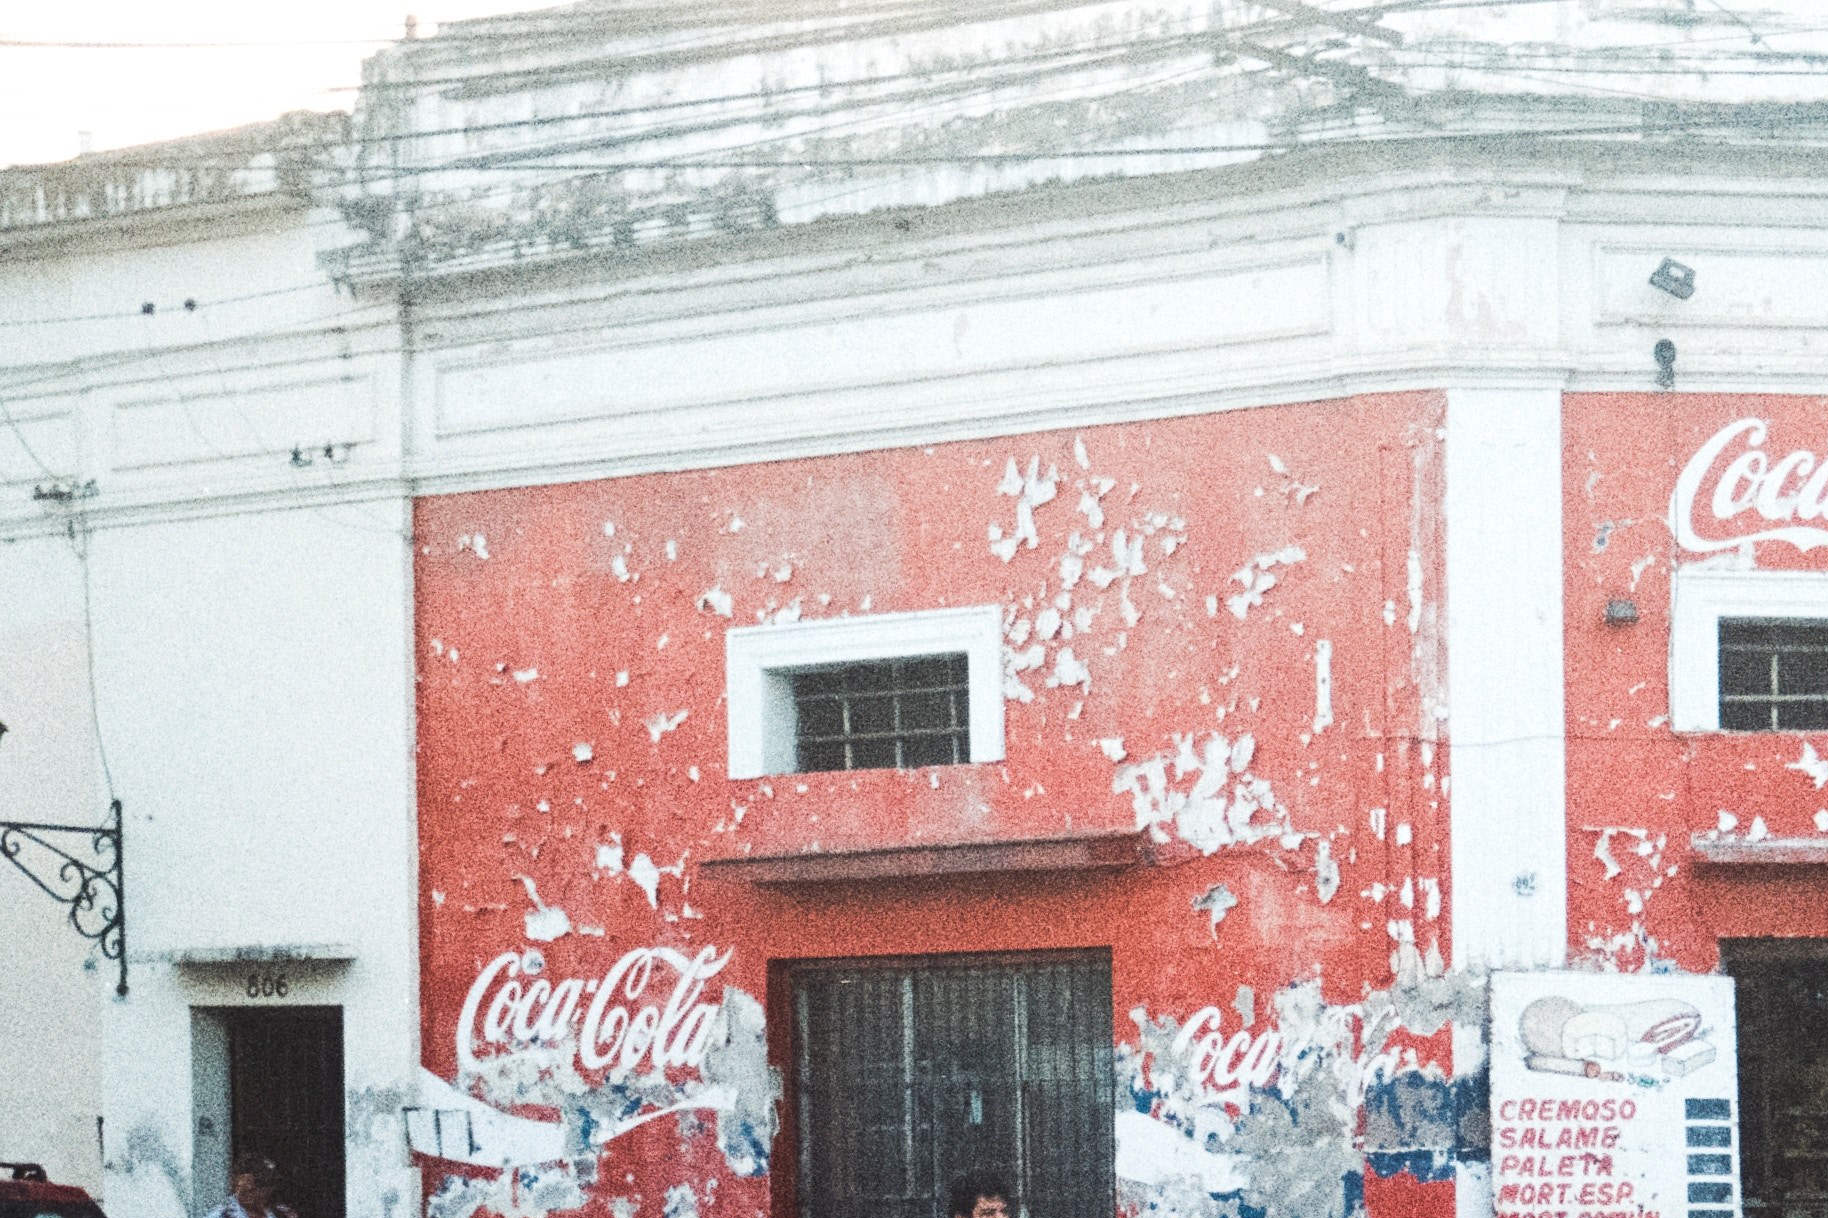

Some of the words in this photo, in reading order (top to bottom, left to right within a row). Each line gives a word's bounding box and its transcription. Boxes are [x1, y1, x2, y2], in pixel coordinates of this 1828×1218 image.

[456, 945, 734, 1072] Coca-Cola
[1499, 1099, 1637, 1122] CREMOSO
[1499, 1127, 1618, 1150] SALAME
[1499, 1154, 1613, 1177] PALETA
